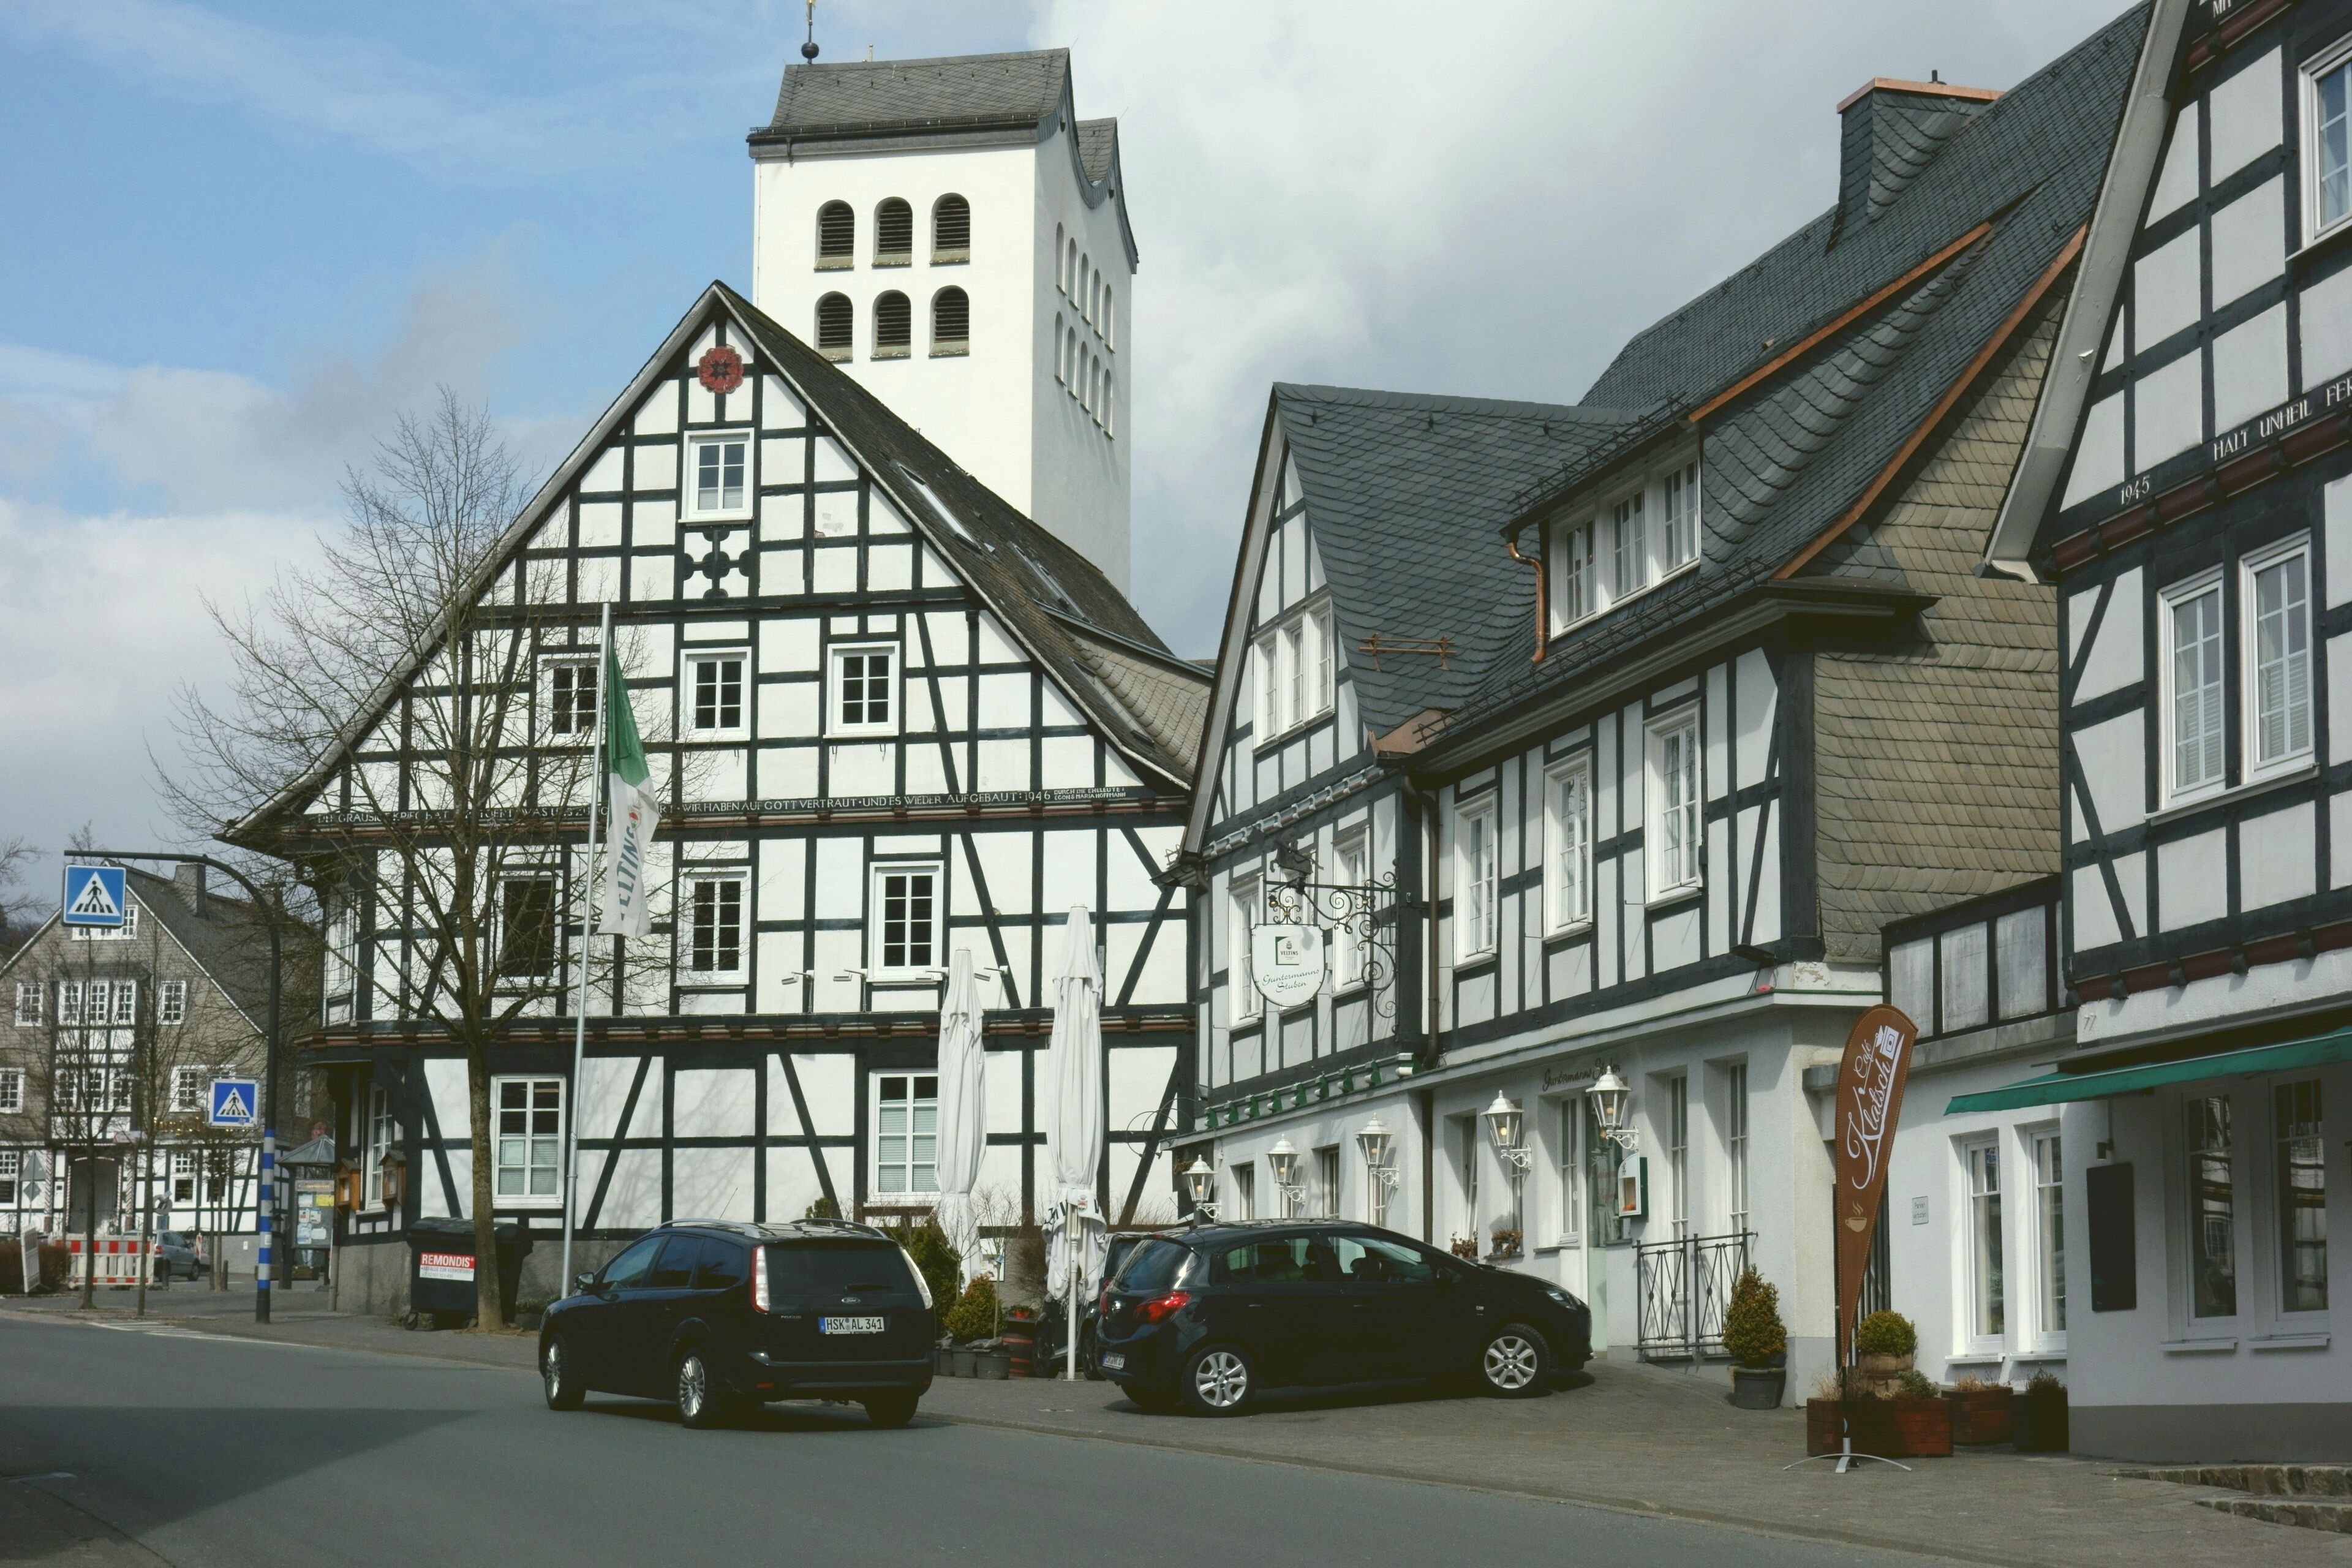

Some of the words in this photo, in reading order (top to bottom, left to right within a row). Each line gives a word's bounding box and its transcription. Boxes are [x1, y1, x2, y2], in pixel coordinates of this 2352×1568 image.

[2120, 474, 2151, 505] 1945
[2213, 427, 2250, 461] HALT
[2260, 398, 2313, 438] UNHEIL
[551, 806, 573, 816] US
[682, 804, 703, 812] WIR
[704, 802, 740, 812] HABEN
[741, 801, 761, 811] AUF
[764, 800, 797, 810] GOTT
[799, 797, 857, 809] VERTRAUT
[862, 796, 886, 807] UND
[889, 796, 902, 806] ES
[904, 795, 942, 805] WIEDER
[1025, 790, 1051, 802] 1946
[1262, 968, 1319, 986] Guntermanns
[1275, 981, 1306, 993] Stuben
[1853, 1038, 1874, 1078] Café
[1542, 1068, 1592, 1091] Guntermanns
[1847, 1058, 1892, 1189] Klatsch
[826, 1319, 845, 1330] HSK
[851, 1319, 863, 1330] AL
[865, 1318, 883, 1330] 341
